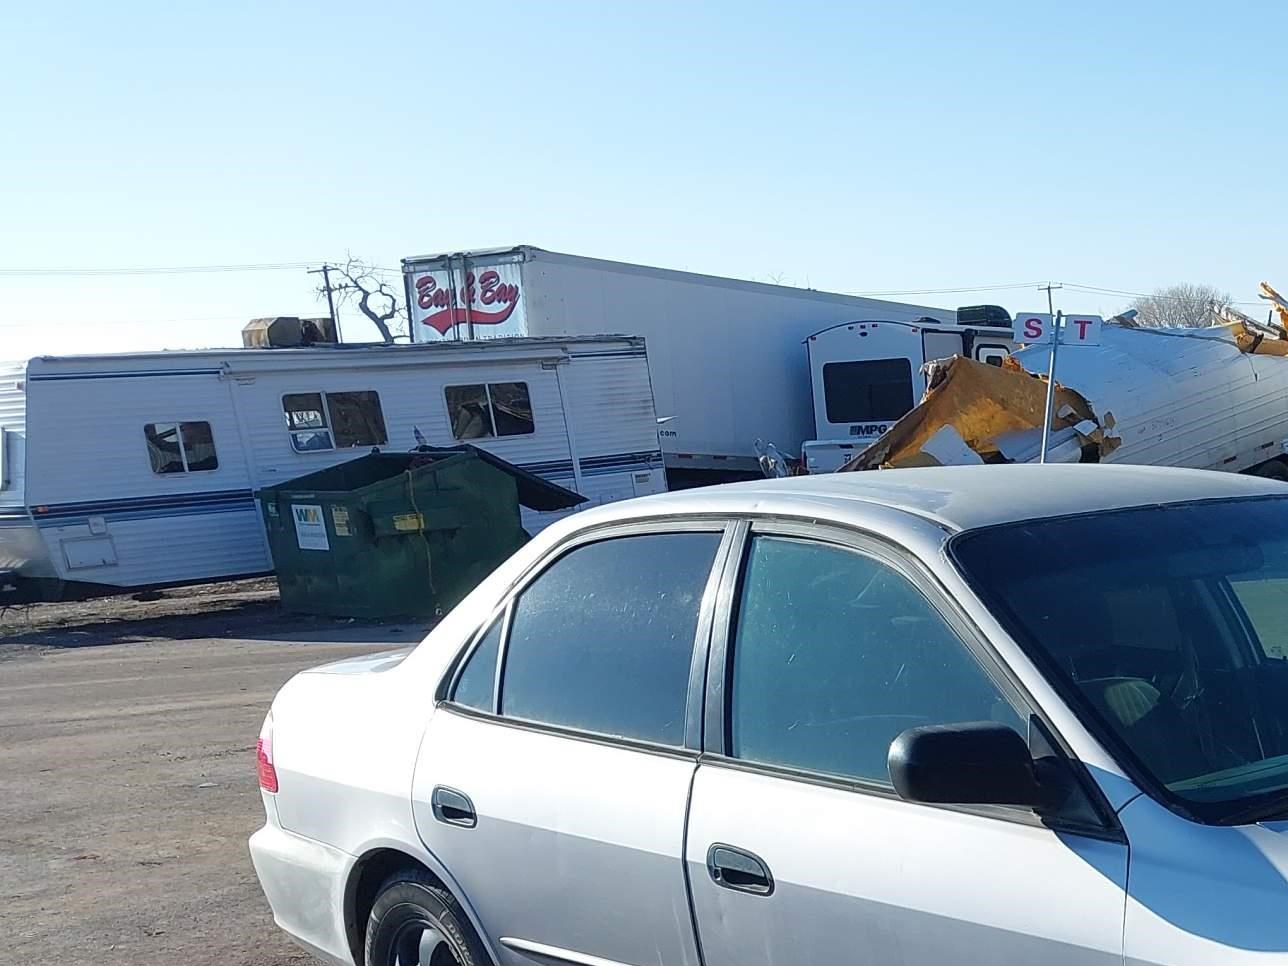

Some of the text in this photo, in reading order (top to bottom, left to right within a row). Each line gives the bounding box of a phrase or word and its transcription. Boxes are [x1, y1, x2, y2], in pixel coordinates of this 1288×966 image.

[479, 271, 520, 308] Bay
[1023, 318, 1043, 339] S
[1073, 320, 1093, 340] T
[295, 508, 319, 522] WM
